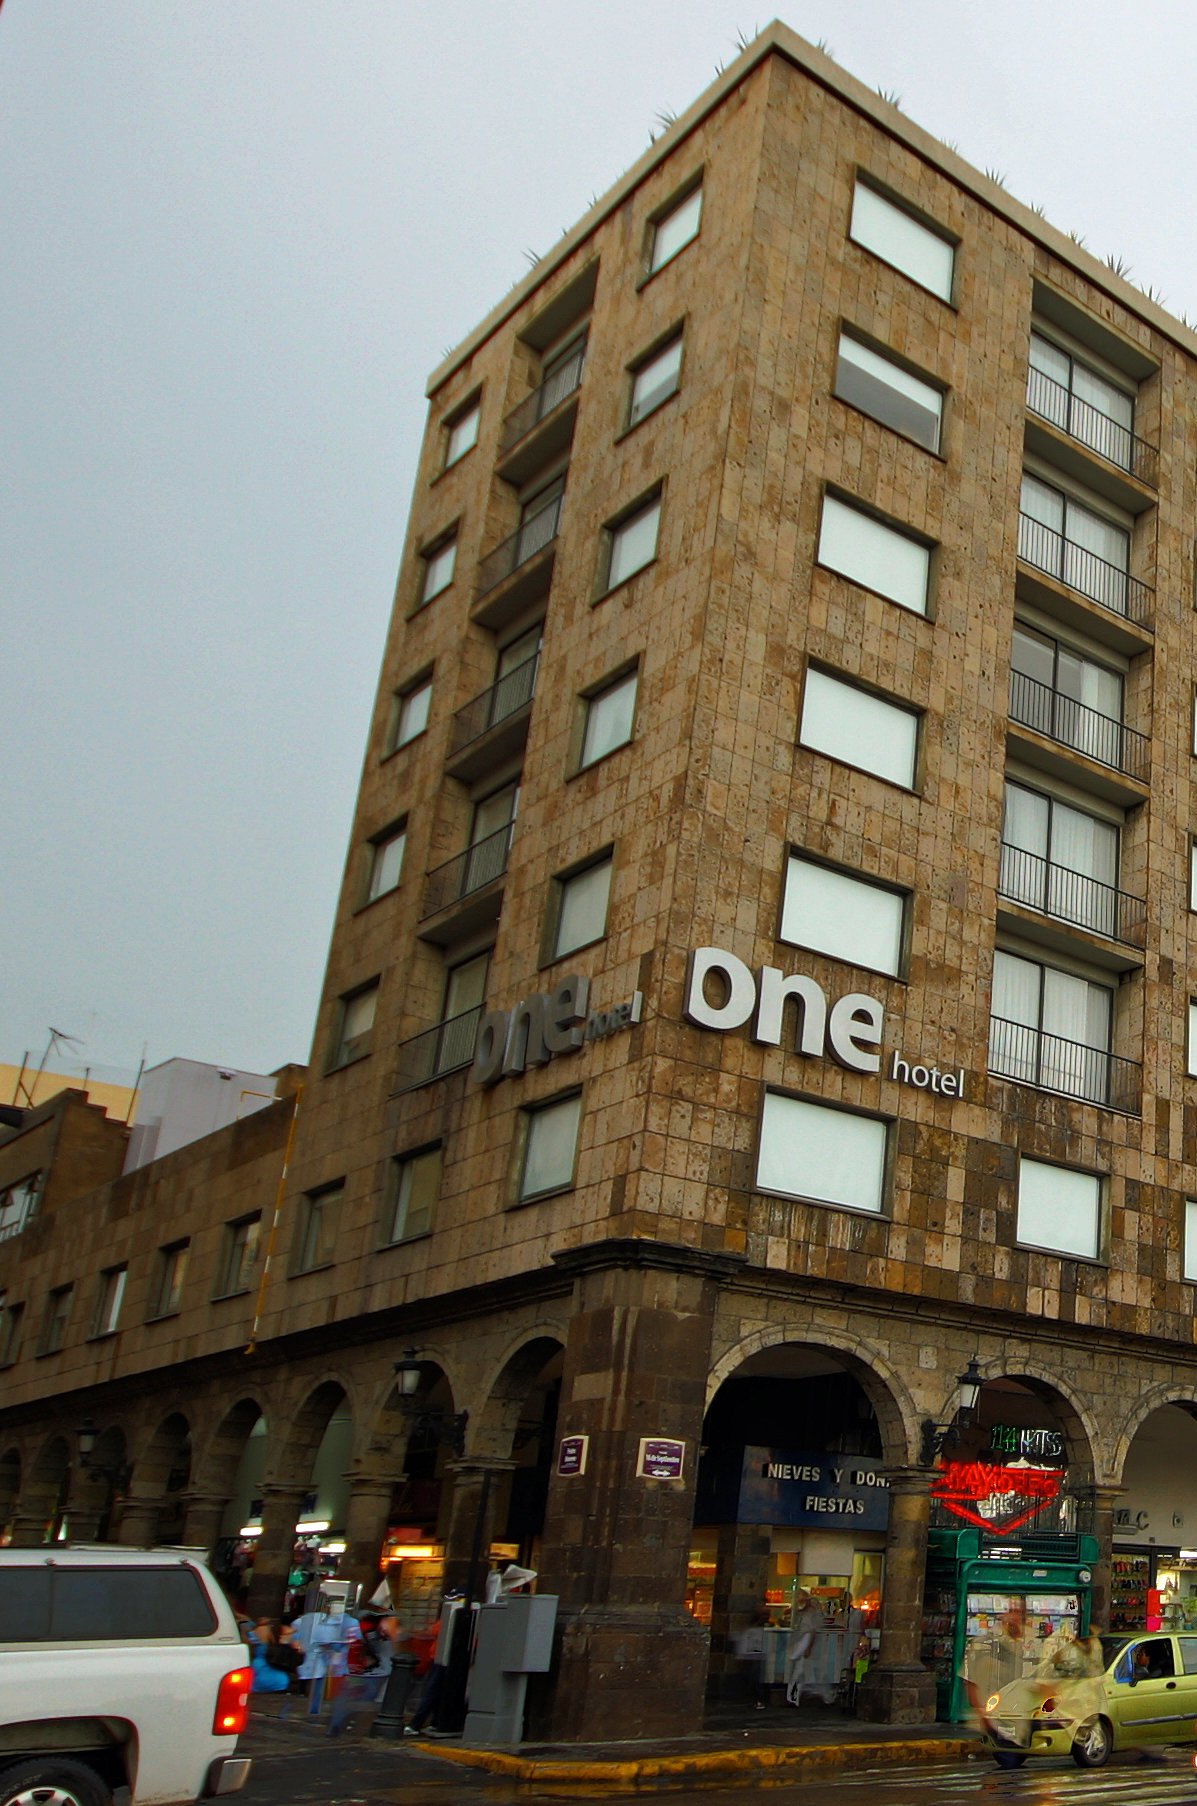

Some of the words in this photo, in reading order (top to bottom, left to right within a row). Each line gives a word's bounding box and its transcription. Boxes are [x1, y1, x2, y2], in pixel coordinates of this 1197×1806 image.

[471, 974, 590, 1083] one
[683, 946, 884, 1073] one
[891, 1050, 966, 1098] hotel
[767, 1463, 821, 1482] NIEVES
[833, 1468, 845, 1484] Y
[855, 1471, 891, 1488] DON
[805, 1495, 865, 1515] FIESTAS
